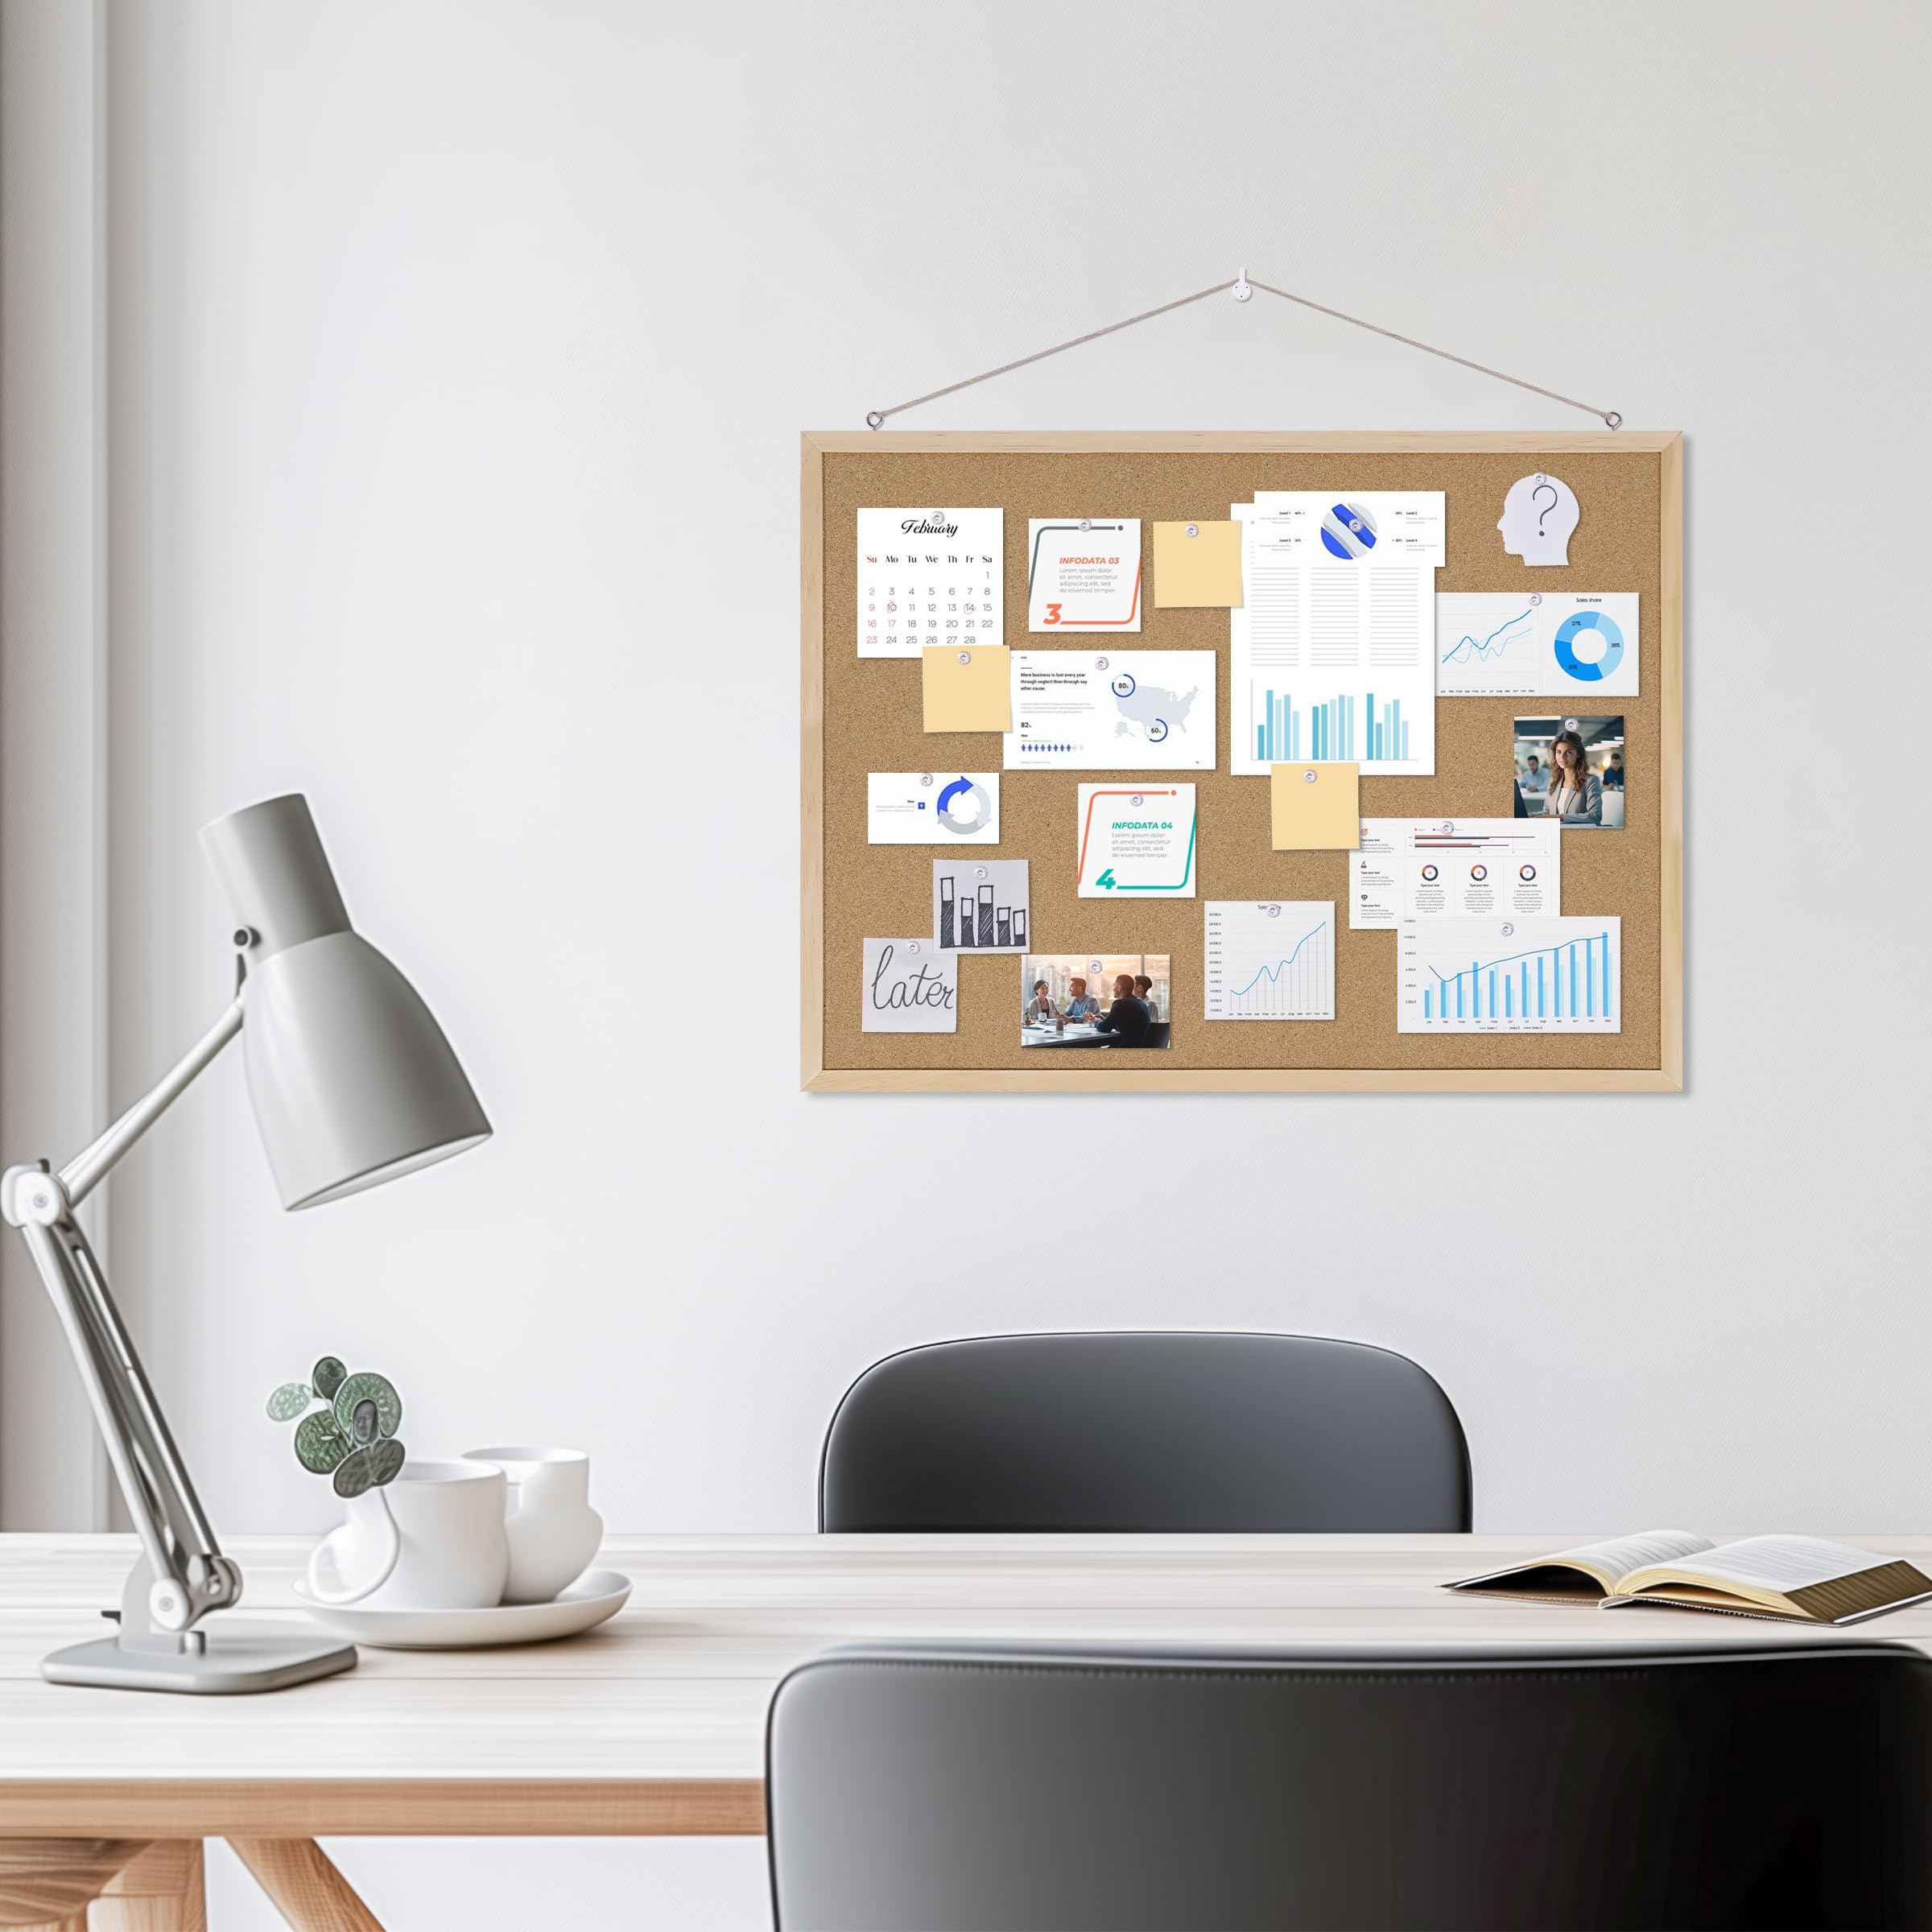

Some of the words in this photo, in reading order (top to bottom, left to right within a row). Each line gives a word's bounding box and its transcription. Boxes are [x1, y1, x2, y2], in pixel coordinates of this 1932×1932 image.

[902, 518, 958, 537] February
[927, 620, 936, 628] 19
[1043, 604, 1063, 625] 3
[866, 636, 877, 644] 23
[1096, 869, 1116, 890] 4
[871, 945, 954, 1010] later
